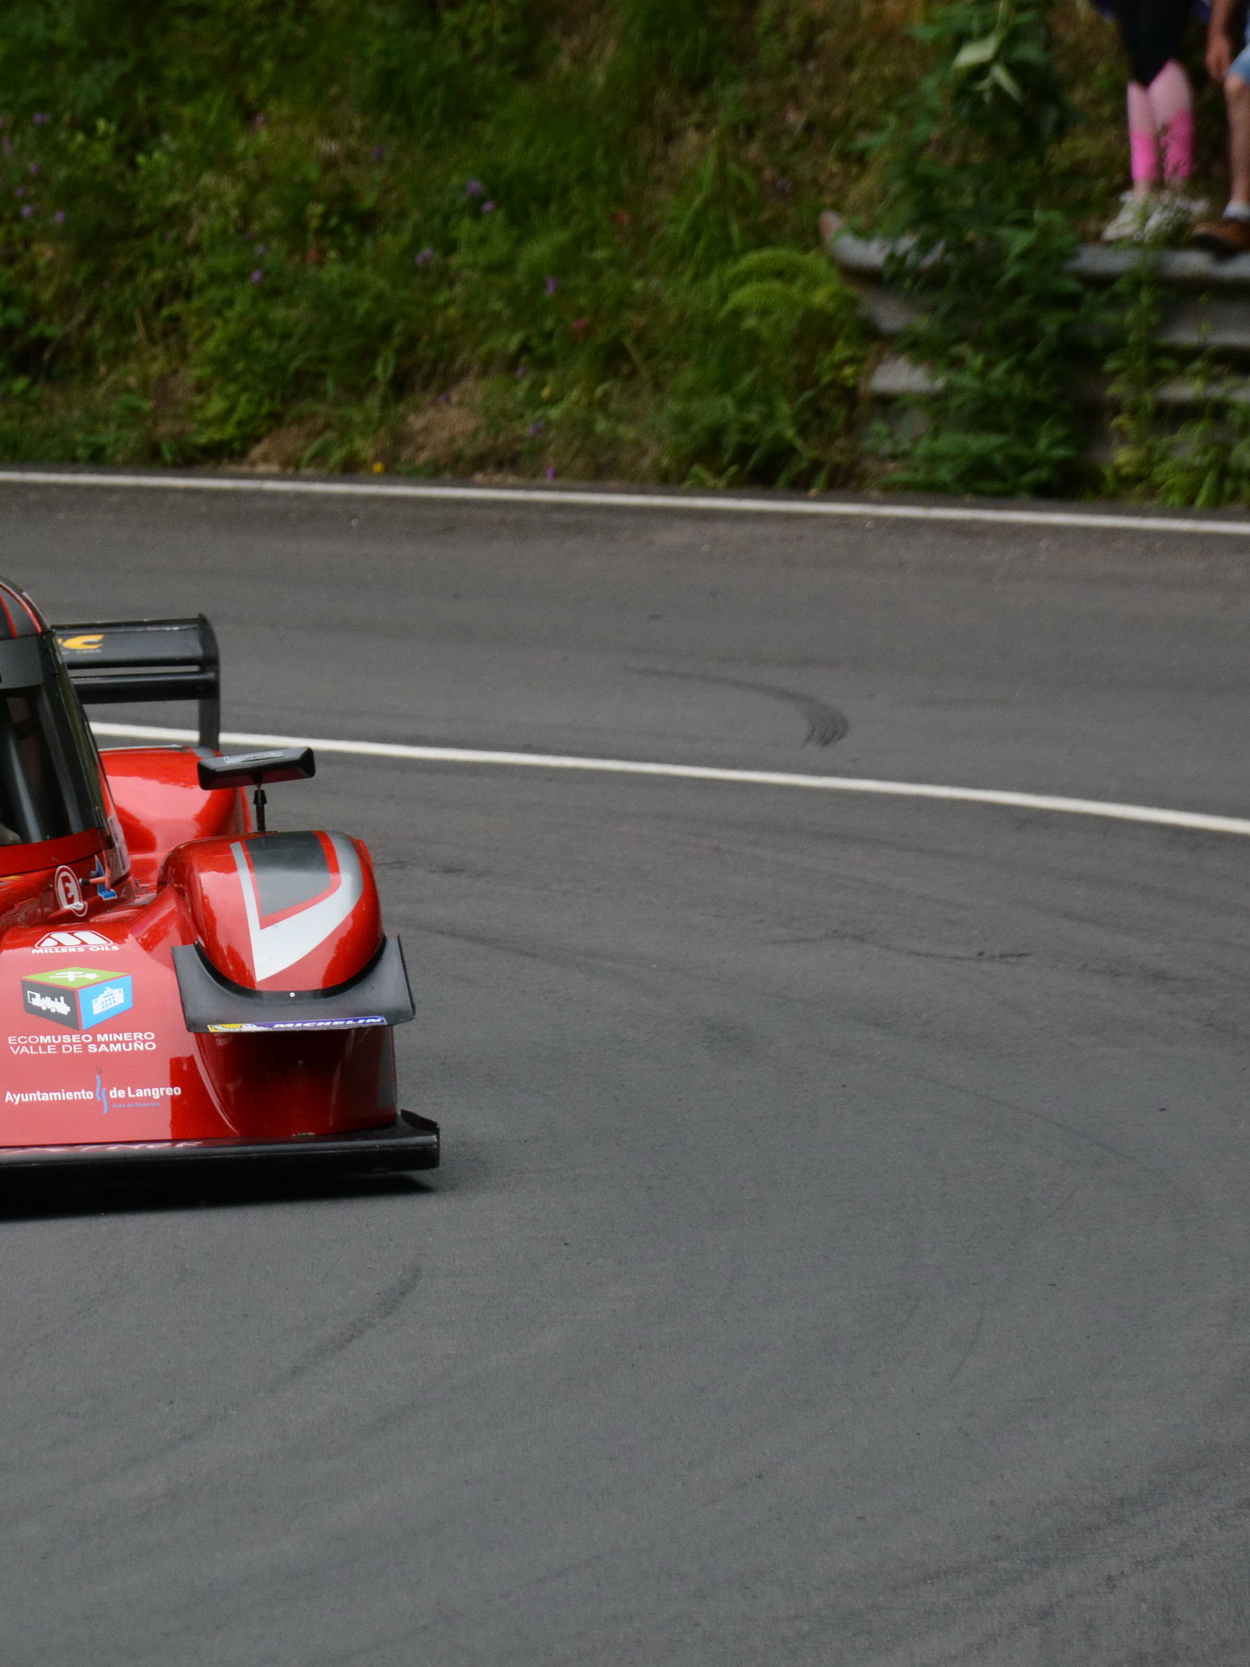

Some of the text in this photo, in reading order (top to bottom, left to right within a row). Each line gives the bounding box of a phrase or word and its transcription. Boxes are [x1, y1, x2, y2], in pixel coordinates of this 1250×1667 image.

[32, 944, 120, 954] MILLERS OILS
[7, 1031, 156, 1045] ECOMUSEO MINERO
[10, 1040, 157, 1055] VALLE DE SAMUÑO
[4, 1085, 182, 1105] Ayuntamiento de Langreo
